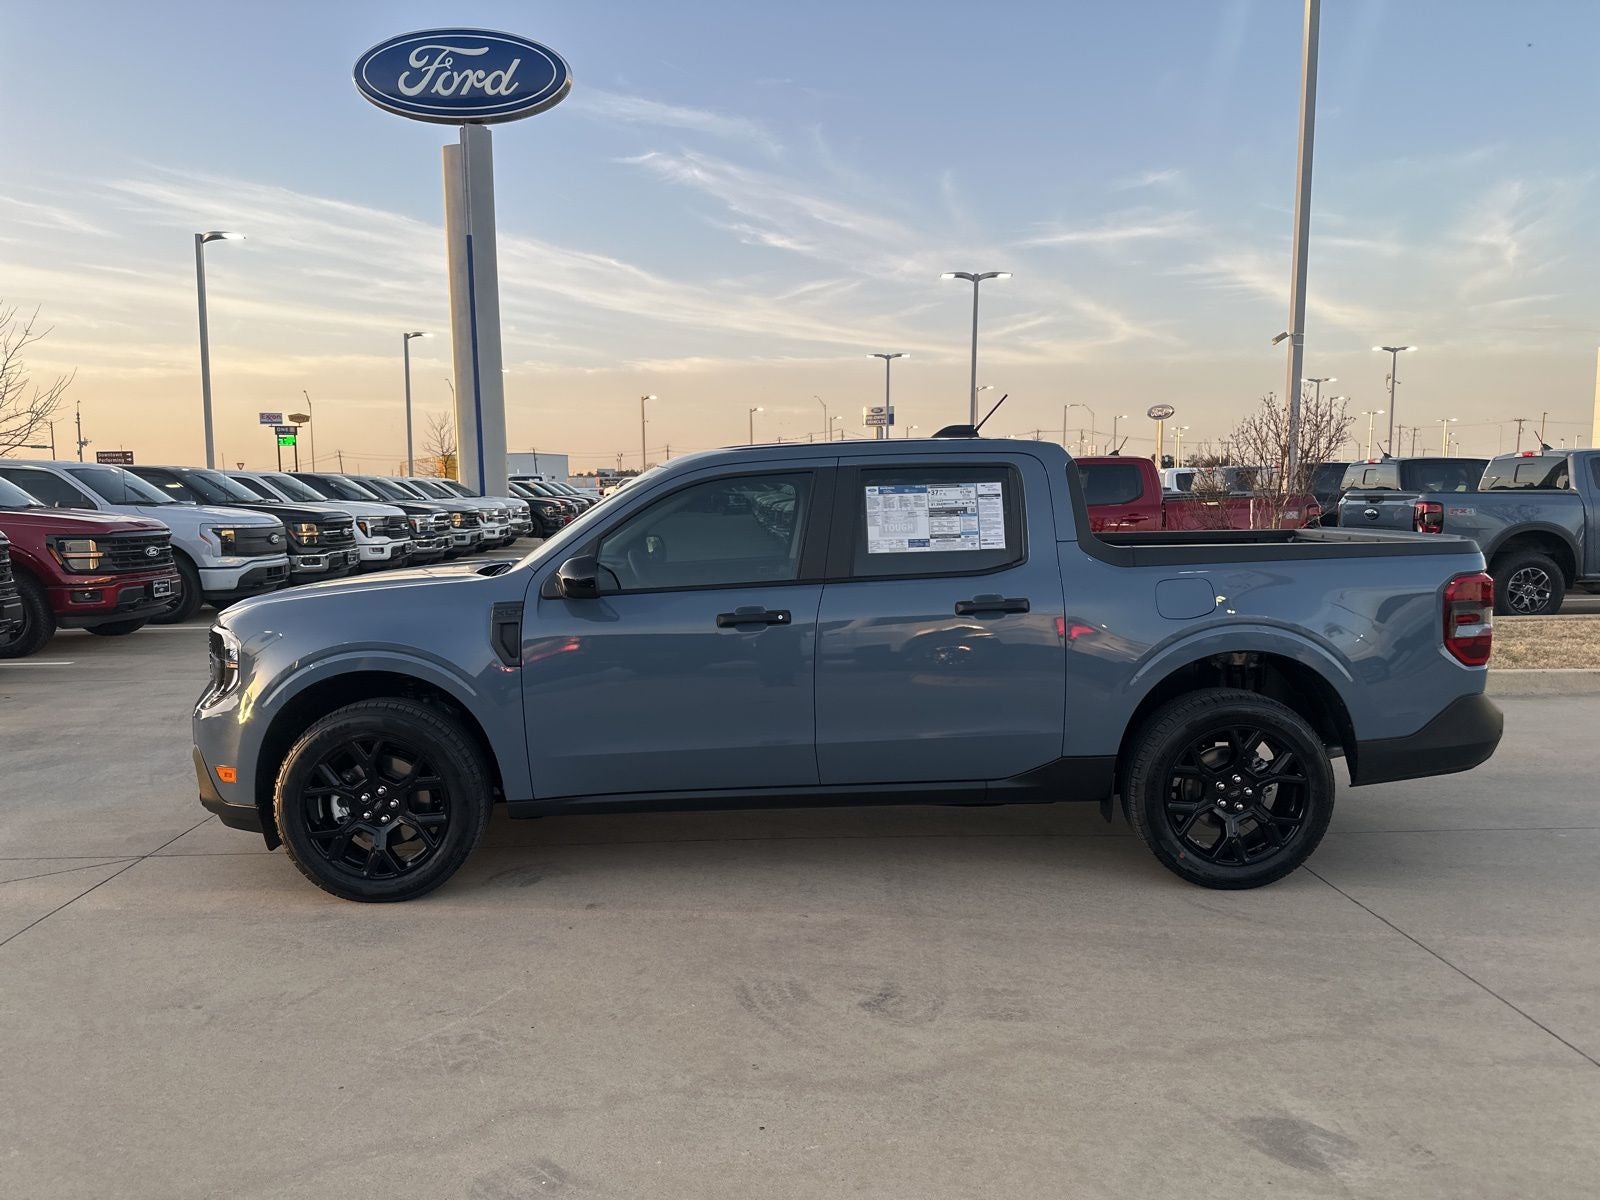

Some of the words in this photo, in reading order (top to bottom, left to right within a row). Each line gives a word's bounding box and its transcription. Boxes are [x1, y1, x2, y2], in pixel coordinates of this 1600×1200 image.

[397, 44, 521, 96] Ford
[1450, 507, 1475, 515] FX4
[884, 523, 914, 532] TOUGH
